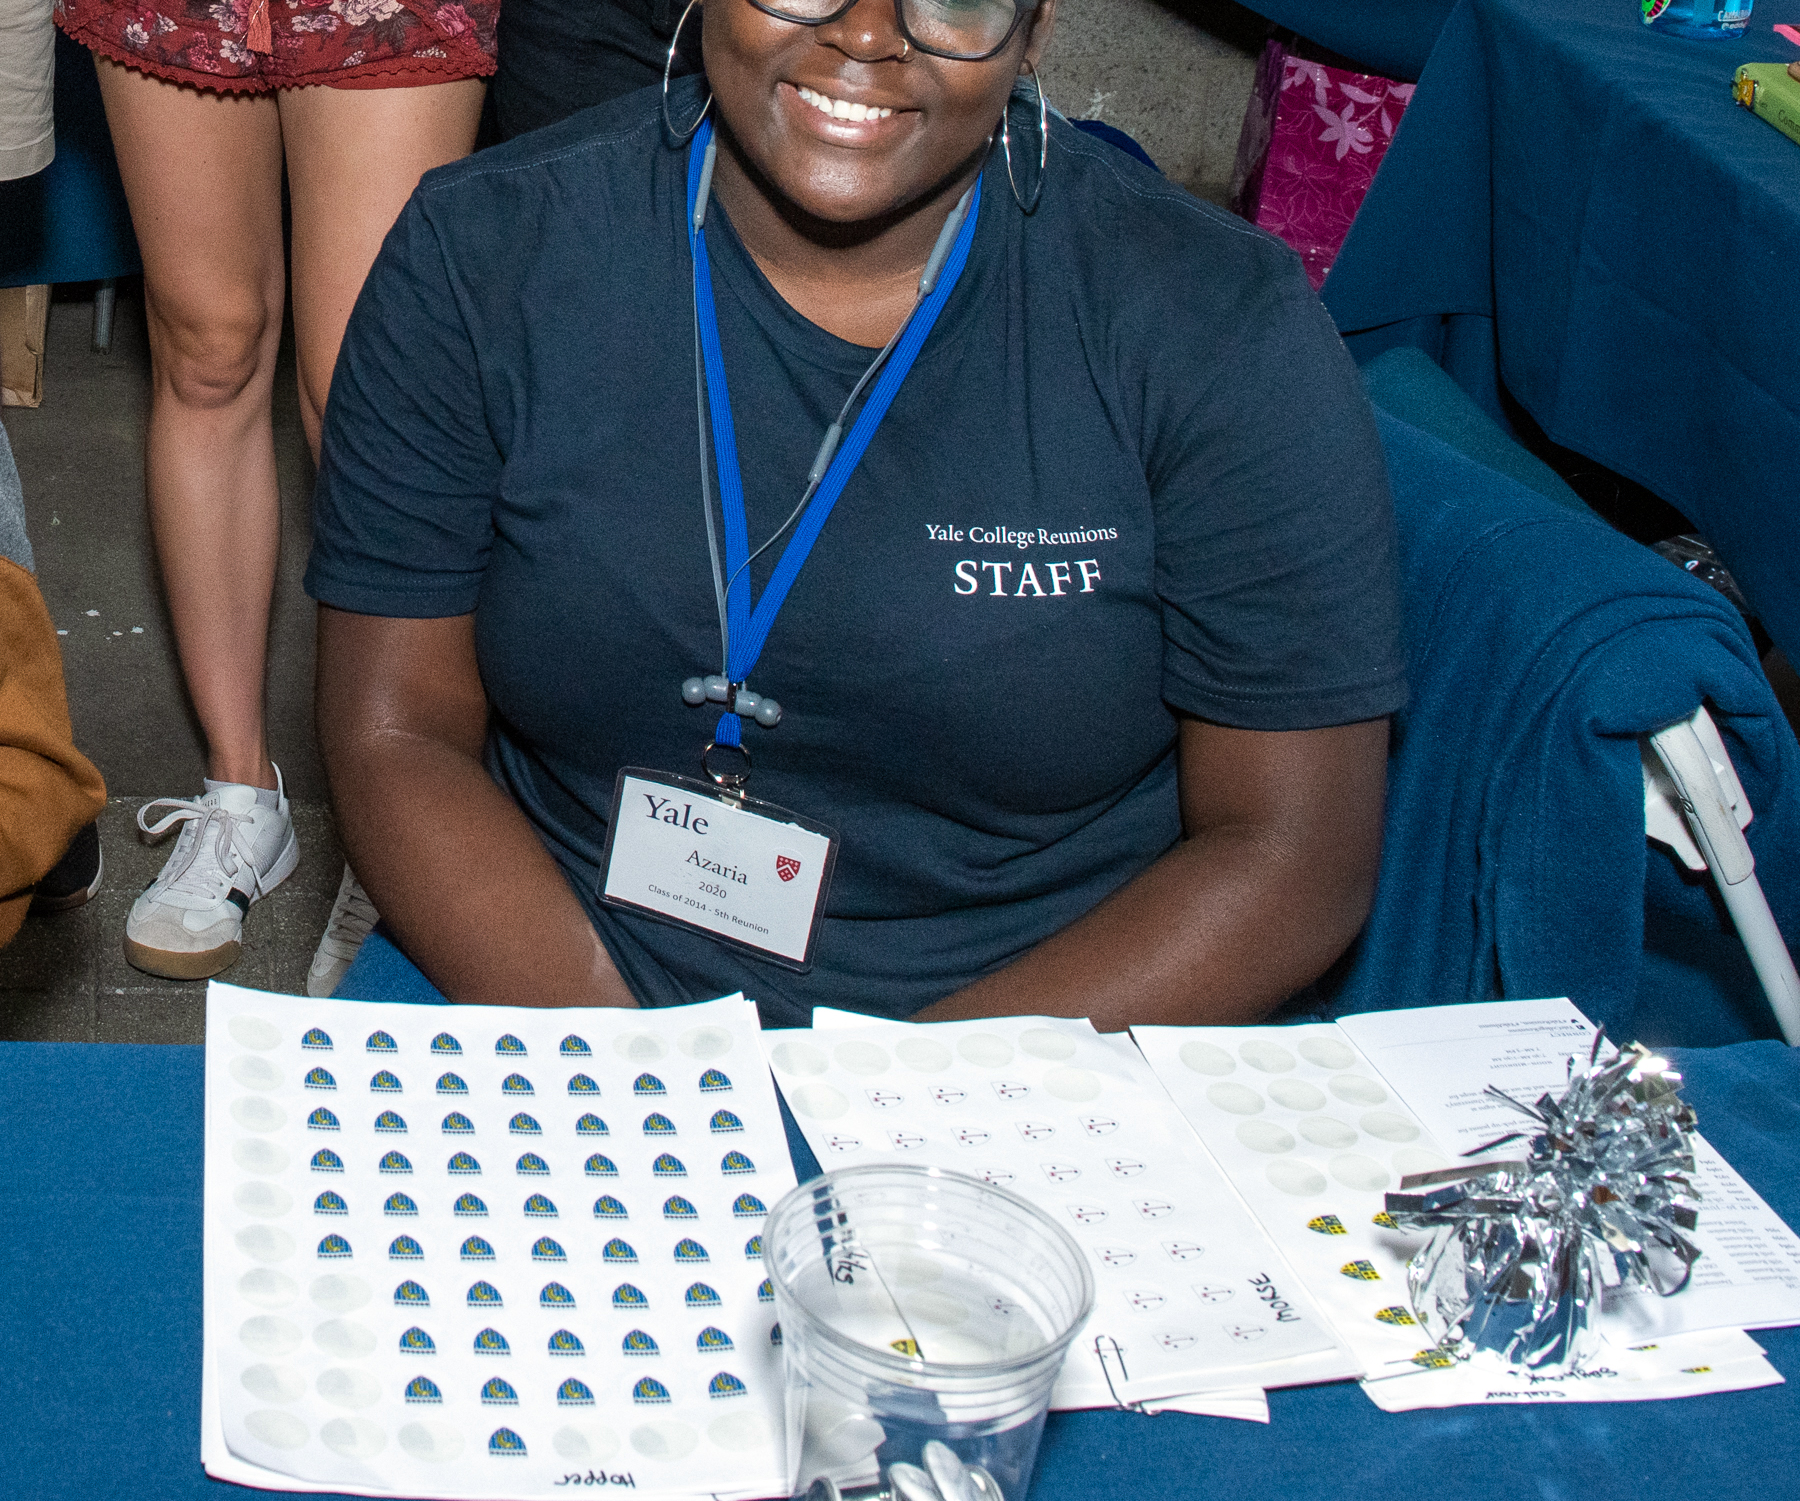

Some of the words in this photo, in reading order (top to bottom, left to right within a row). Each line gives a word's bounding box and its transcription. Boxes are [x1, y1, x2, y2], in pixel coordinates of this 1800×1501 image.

[926, 524, 963, 541] Yale
[969, 526, 1035, 549] College
[1037, 526, 1118, 544] Reunions
[954, 559, 1101, 597] STAFF
[643, 794, 709, 835] Yale
[685, 850, 748, 885] Azaria
[698, 882, 727, 899] 2020
[648, 884, 671, 898] Class
[672, 893, 683, 902] of
[684, 897, 706, 911] 2014
[714, 908, 729, 921] 5th
[731, 915, 769, 935] Reunion
[1246, 1272, 1301, 1323] MORSE
[554, 1470, 636, 1489] Hopper
